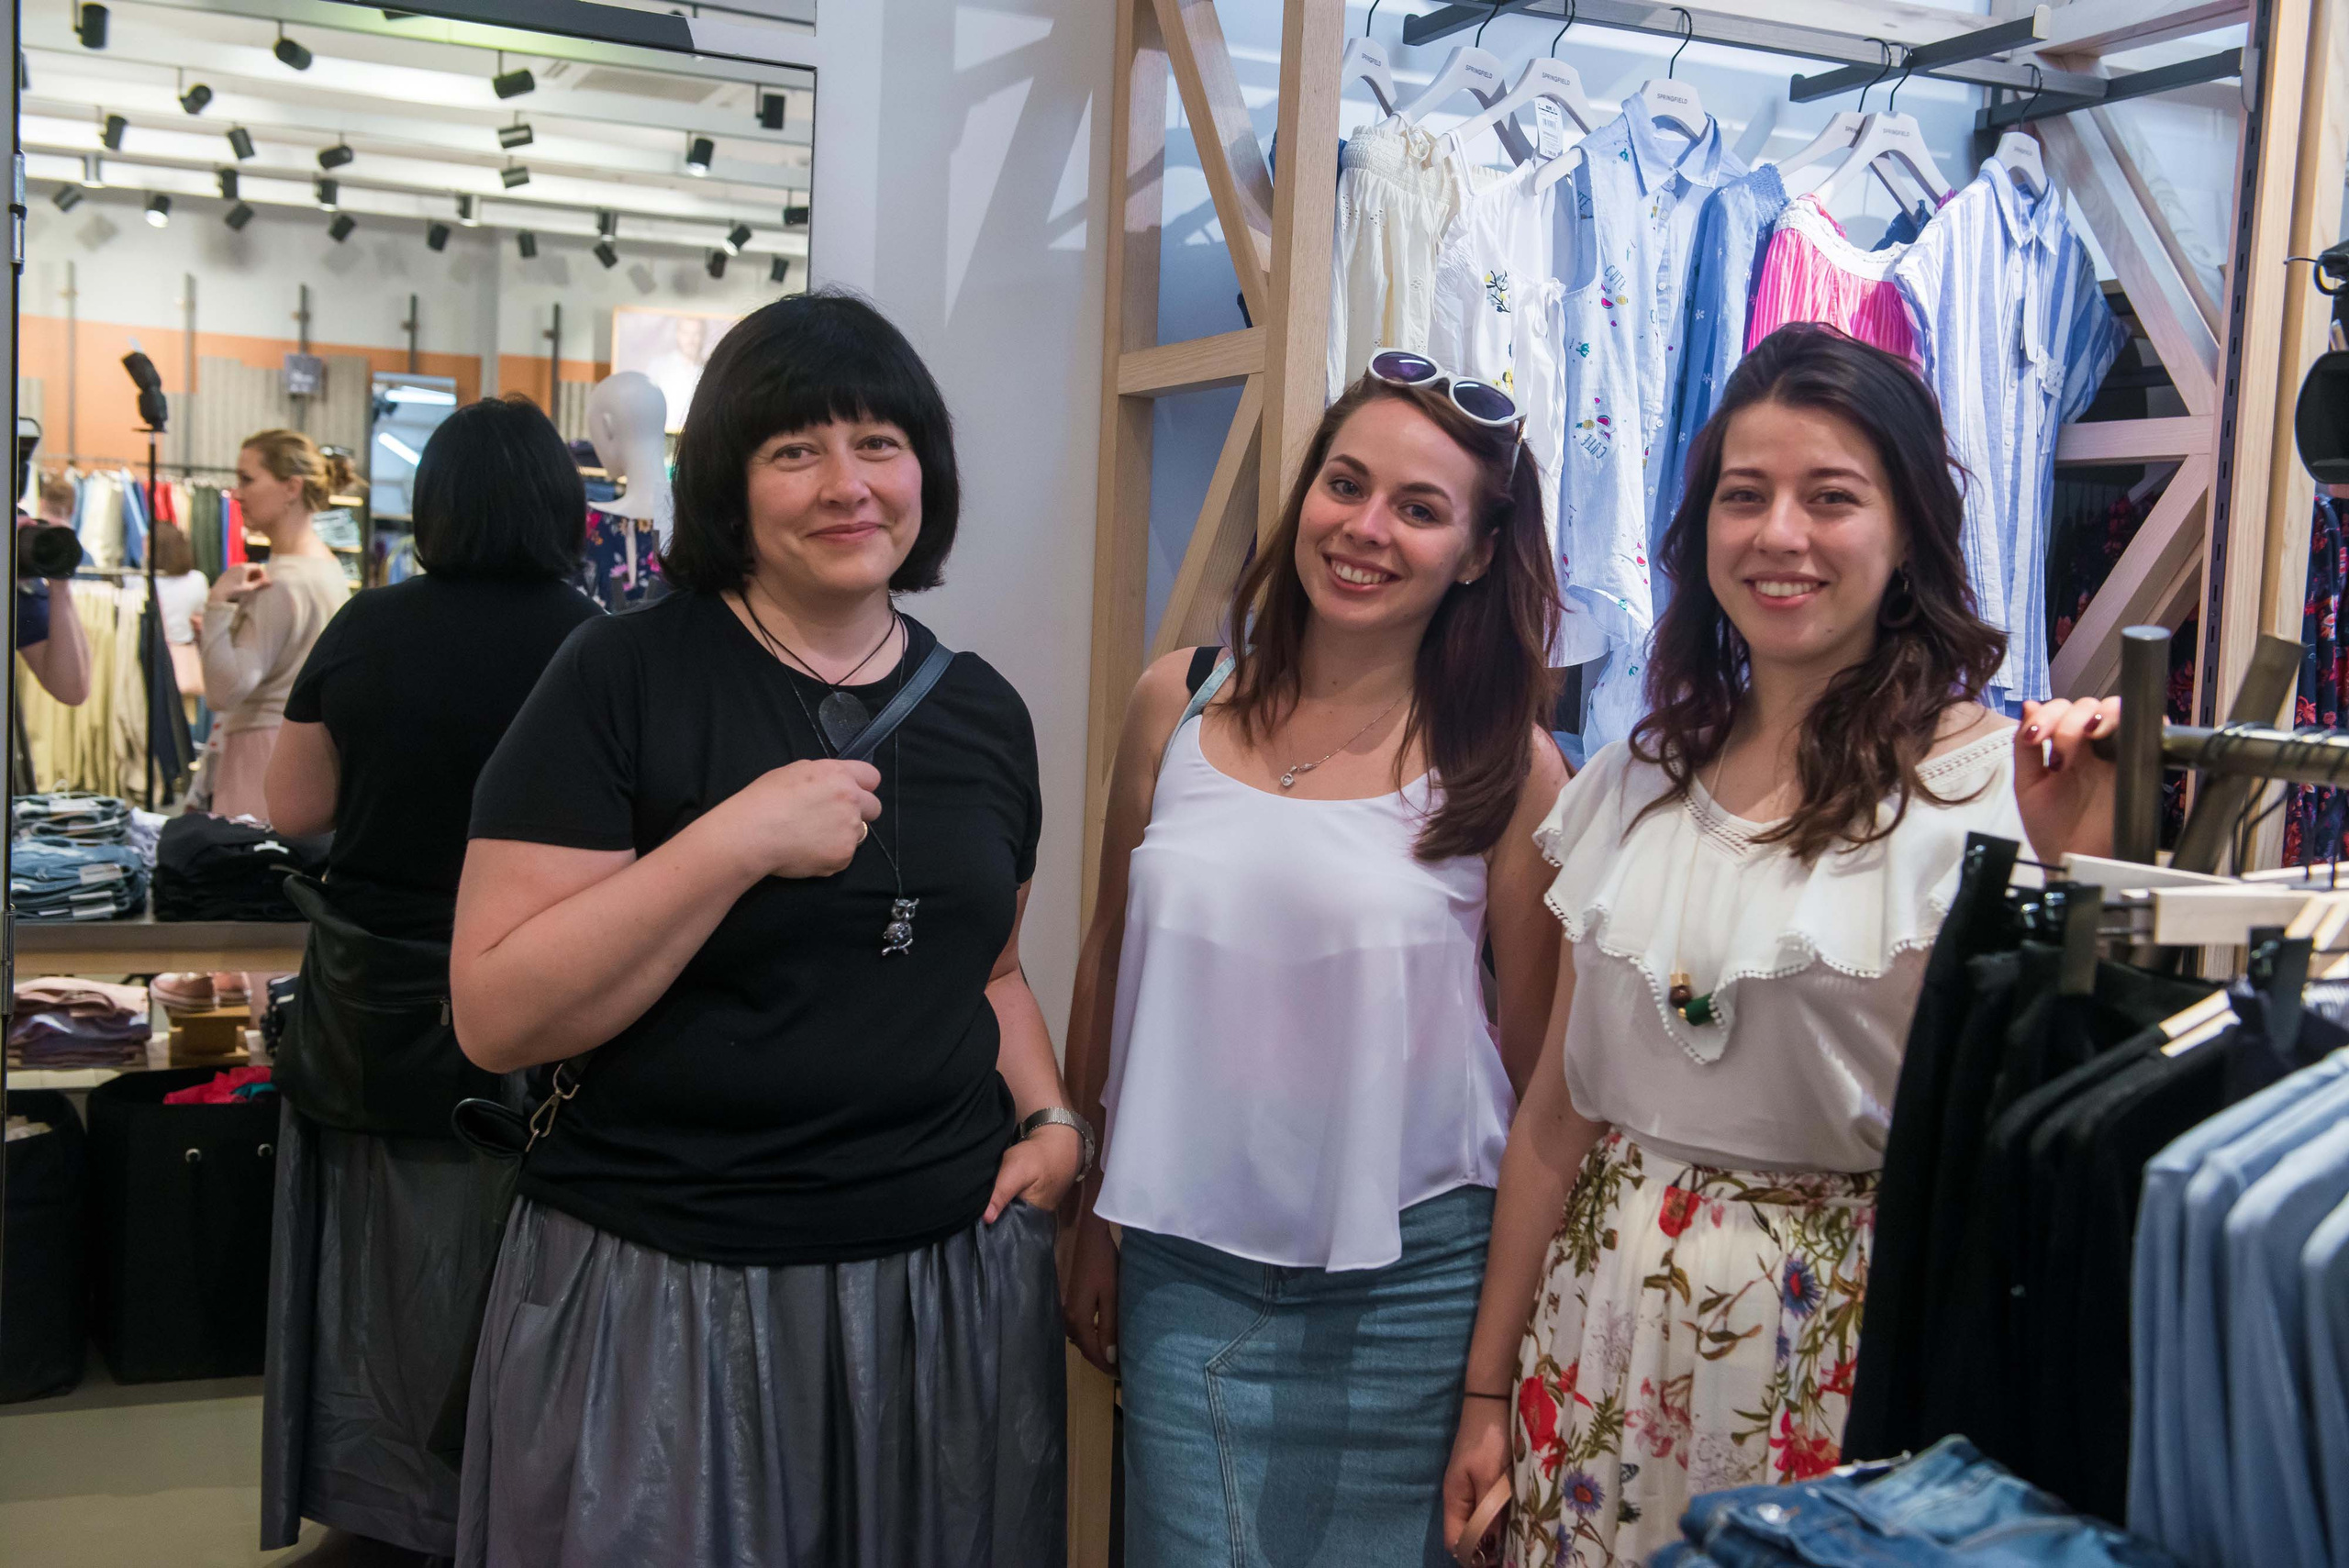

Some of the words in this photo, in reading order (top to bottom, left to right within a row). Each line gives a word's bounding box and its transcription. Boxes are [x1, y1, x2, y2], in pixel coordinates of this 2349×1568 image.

[1465, 64, 1493, 79] SPRINGFIELD
[1542, 72, 1570, 85] SPRINGFIELD
[1656, 93, 1688, 105] SPRINGFIELD
[1605, 264, 1626, 291] CUTE
[1580, 433, 1608, 459] CUTE
